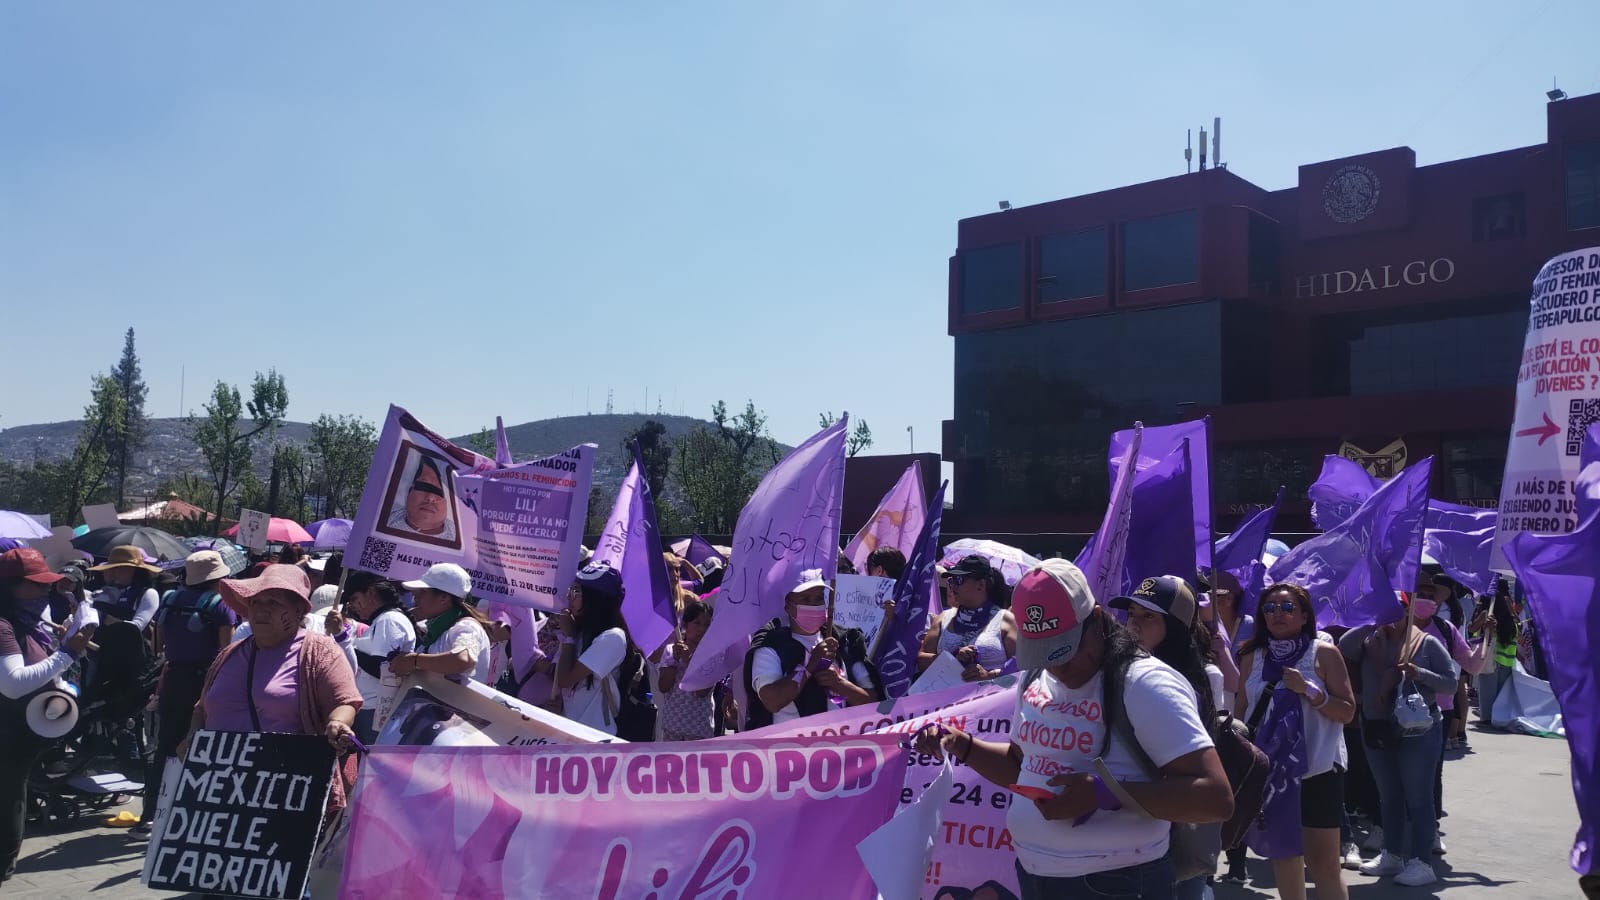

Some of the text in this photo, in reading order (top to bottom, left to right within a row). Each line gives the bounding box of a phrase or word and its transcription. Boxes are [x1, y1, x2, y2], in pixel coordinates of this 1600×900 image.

[1588, 253, 1600, 269] D
[1295, 258, 1455, 299] HIDALGO
[1561, 271, 1600, 290] FEMIN
[1533, 290, 1588, 313] ESCUDERO
[1535, 338, 1557, 361] ESTÁ
[1560, 340, 1575, 356] EL
[1580, 338, 1600, 355] CO
[1534, 375, 1585, 398] JOVENES
[532, 474, 577, 488] FEMINICIDIO
[1522, 476, 1545, 495] MÁS
[1547, 480, 1567, 495] DE
[503, 485, 551, 499] HOY GRITO POR
[515, 498, 536, 512] LILI
[1503, 498, 1577, 514] EXIGIENDO JUS
[482, 509, 568, 529] PORQUE ELLA YA NO
[1509, 517, 1520, 531] DE
[1521, 516, 1560, 532] ENERO
[1564, 517, 1579, 533] D
[489, 521, 558, 539] PUEDE HACERLO
[412, 556, 423, 565] DE
[486, 583, 509, 595] OLVIDA
[534, 585, 558, 596] ENERO
[1022, 618, 1059, 633] ARIAT
[187, 729, 262, 768] QUE
[532, 746, 878, 796] HOY GRITO POR
[175, 766, 313, 812] MÉXICO
